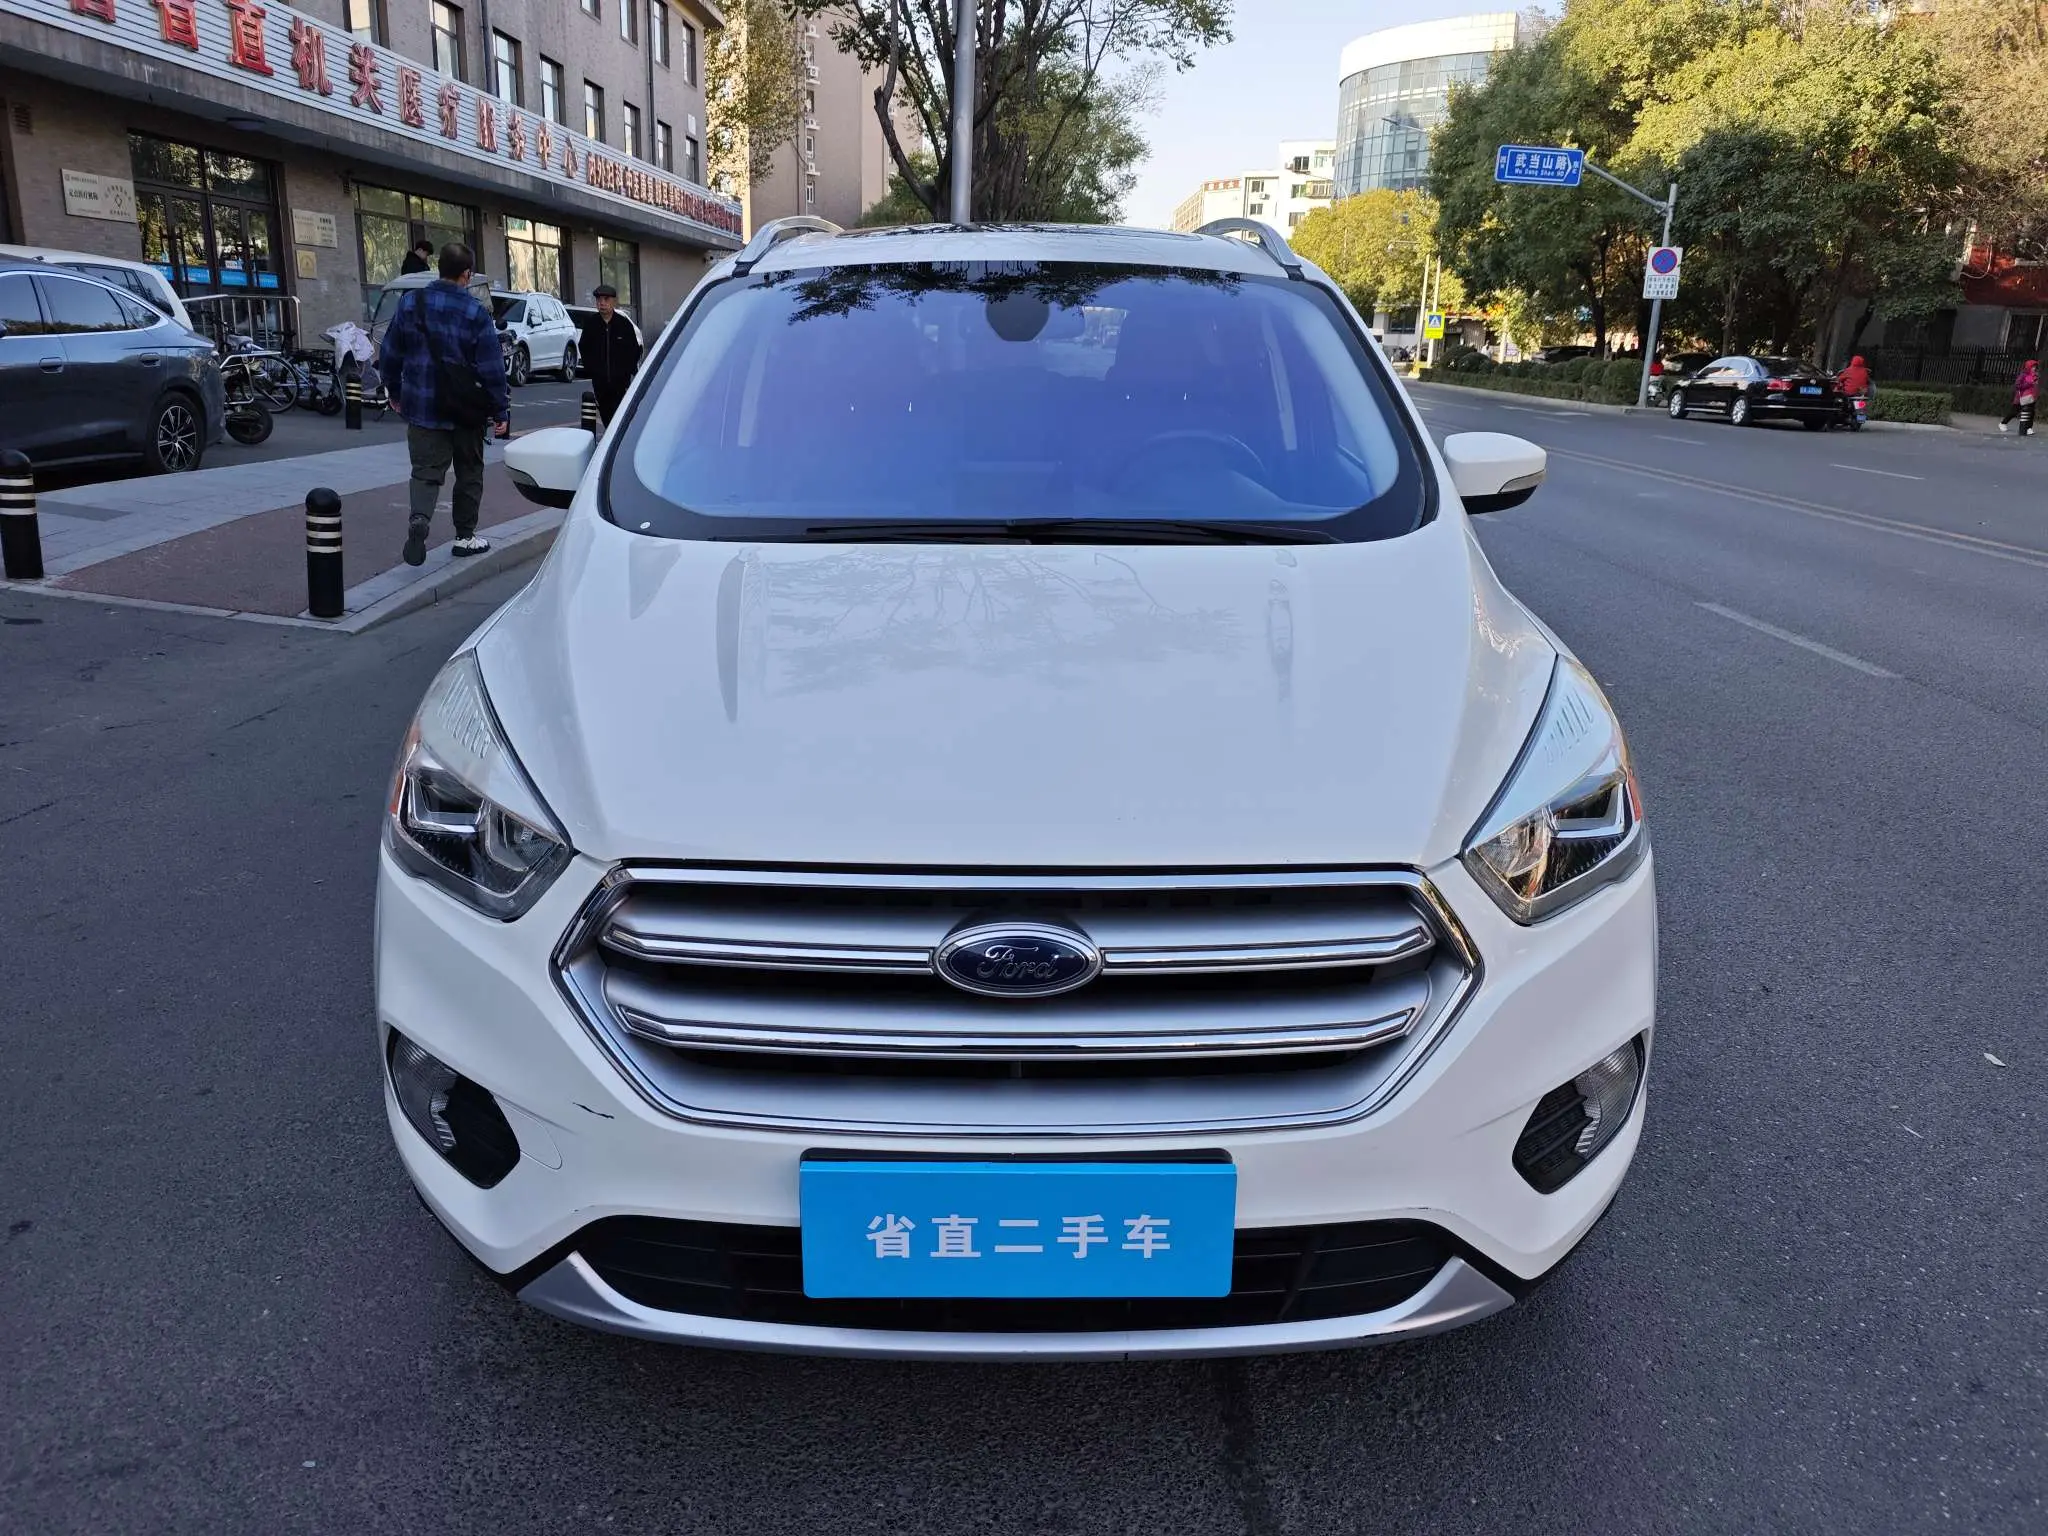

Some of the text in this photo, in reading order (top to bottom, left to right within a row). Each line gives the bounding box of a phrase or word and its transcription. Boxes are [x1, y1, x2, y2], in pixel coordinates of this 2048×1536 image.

[1514, 153, 1567, 170] 武当山路
[976, 944, 1059, 980] Ford
[866, 1213, 1170, 1259] 省直二手车
